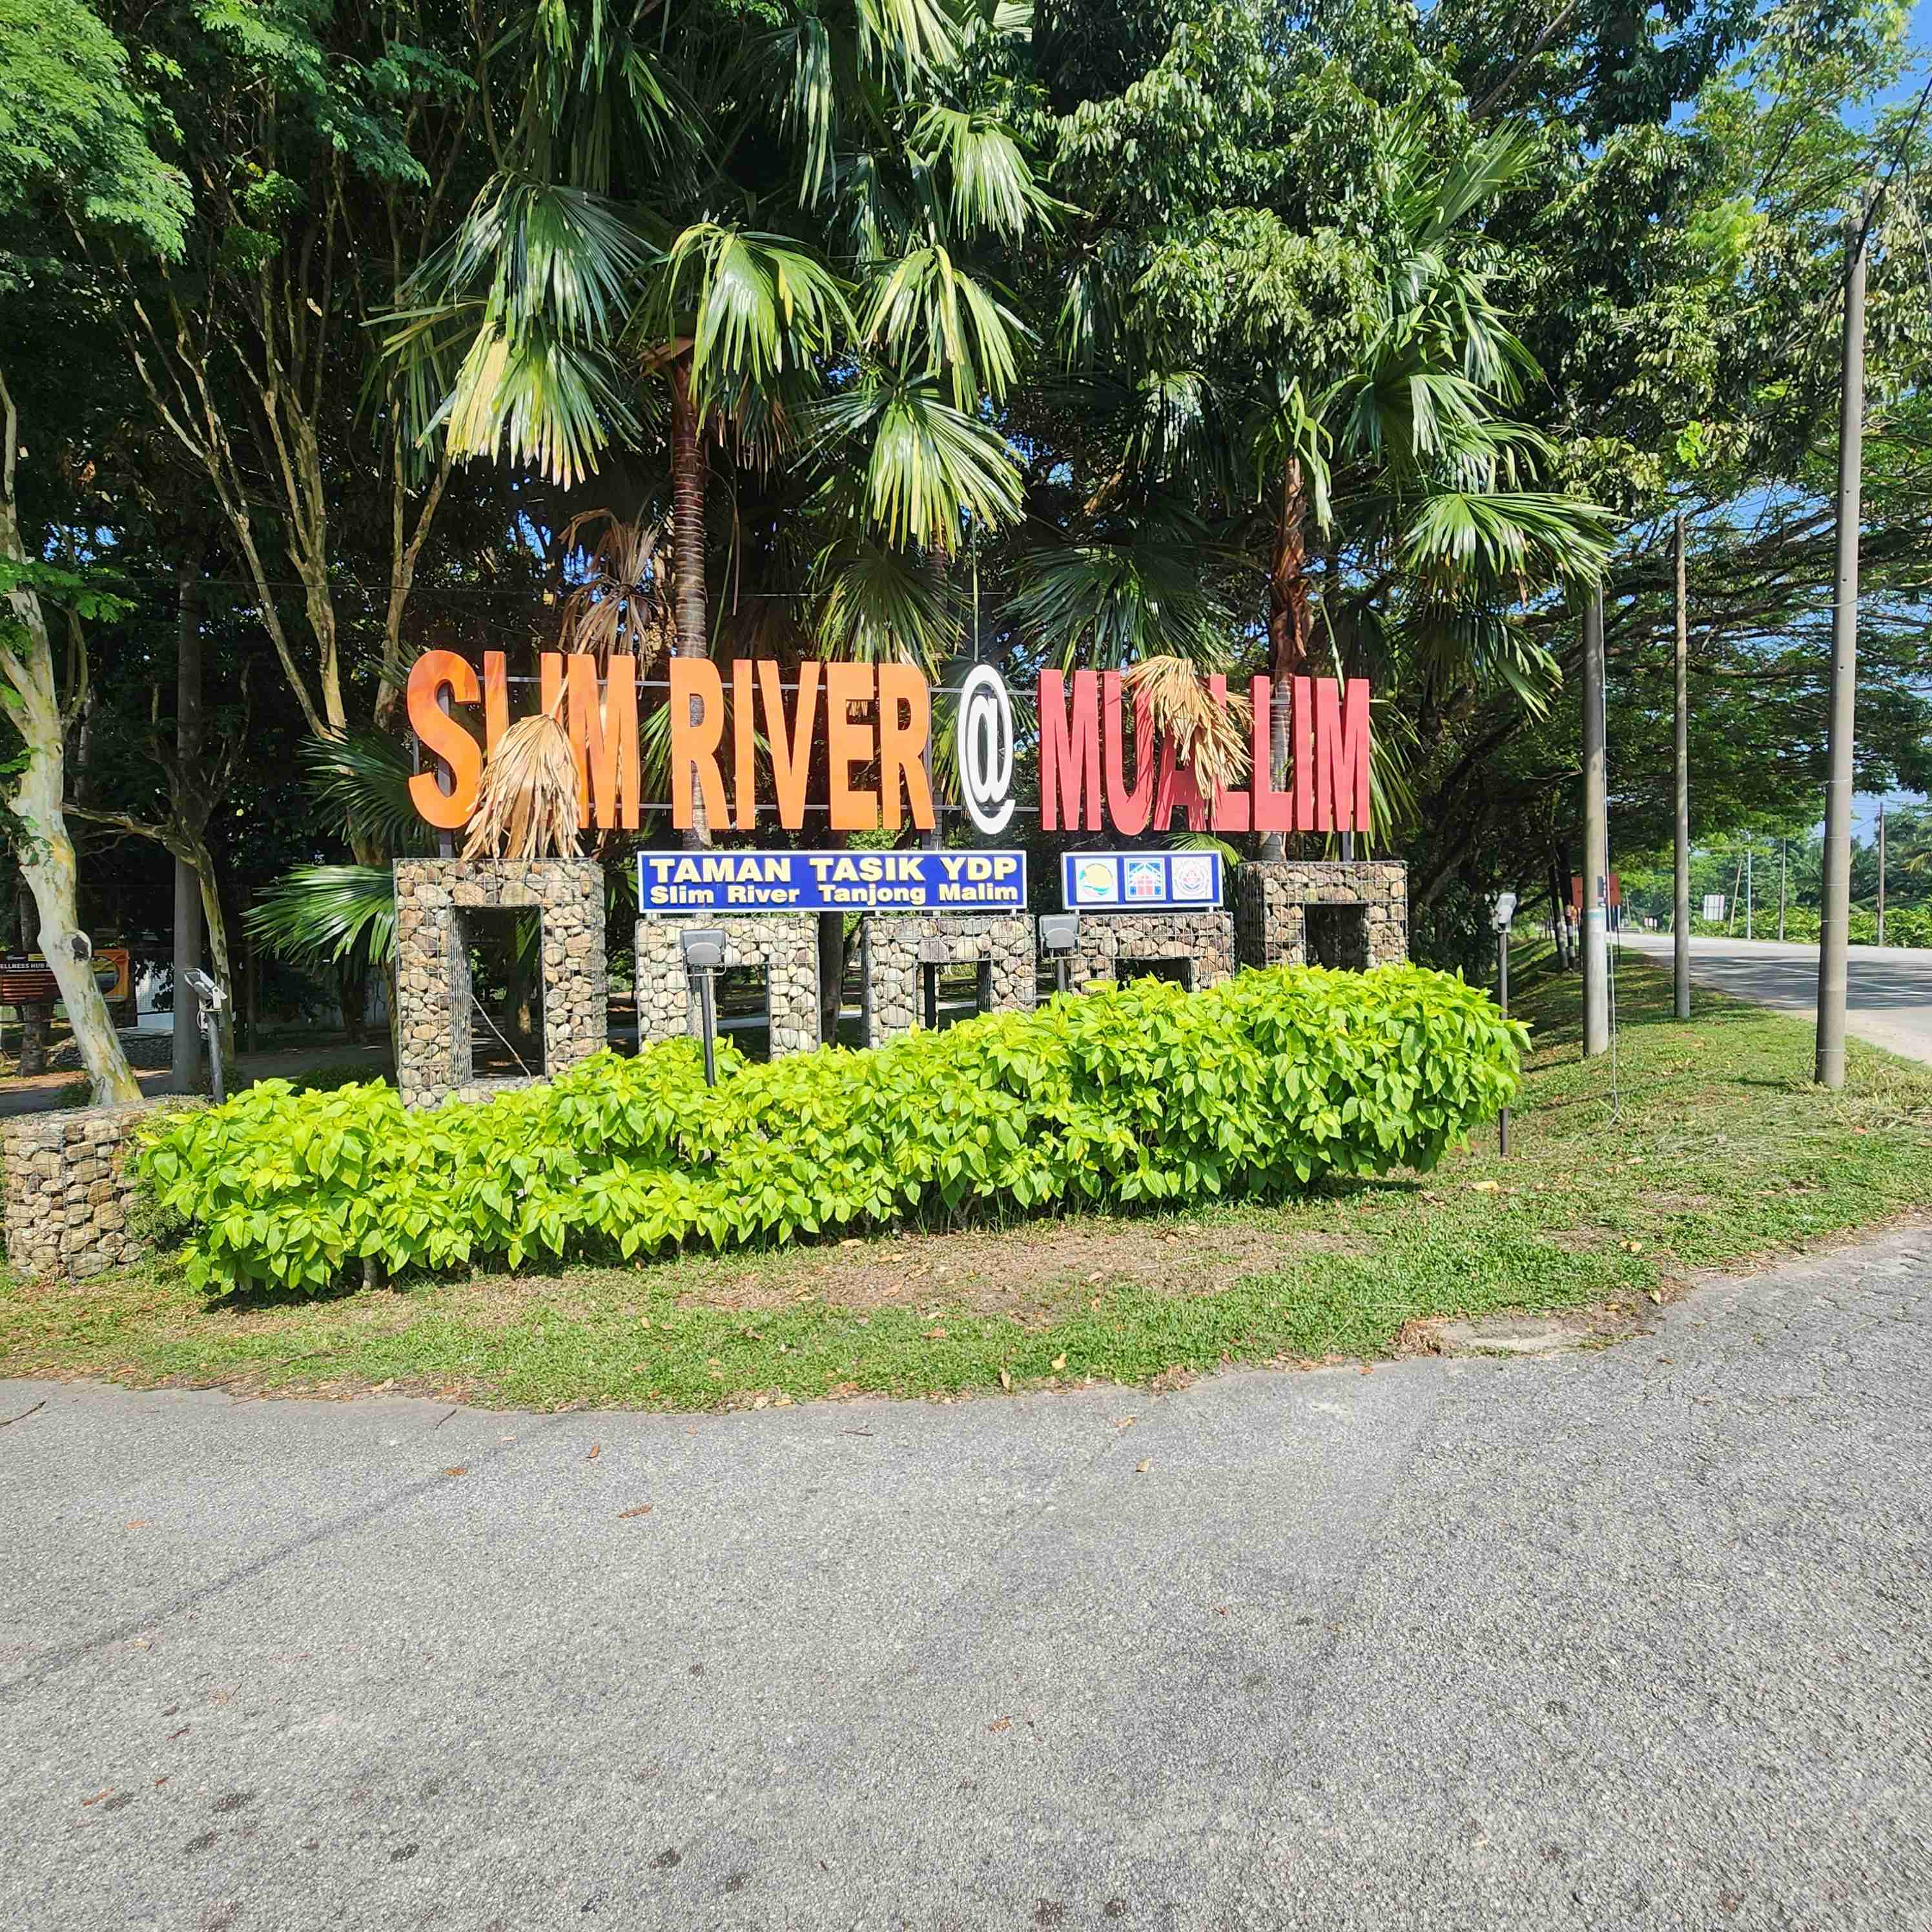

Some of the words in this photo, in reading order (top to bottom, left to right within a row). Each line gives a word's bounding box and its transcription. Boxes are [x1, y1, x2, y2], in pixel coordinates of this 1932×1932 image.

[669, 657, 936, 830] RIVER
[957, 664, 1016, 835] @
[648, 857, 792, 883] TAMAN
[808, 856, 926, 882] TASIK
[940, 856, 1018, 881] YDP
[650, 884, 714, 905] Slim
[727, 885, 800, 903] River
[817, 883, 927, 906] Tanjong
[938, 882, 1018, 901] Malim
